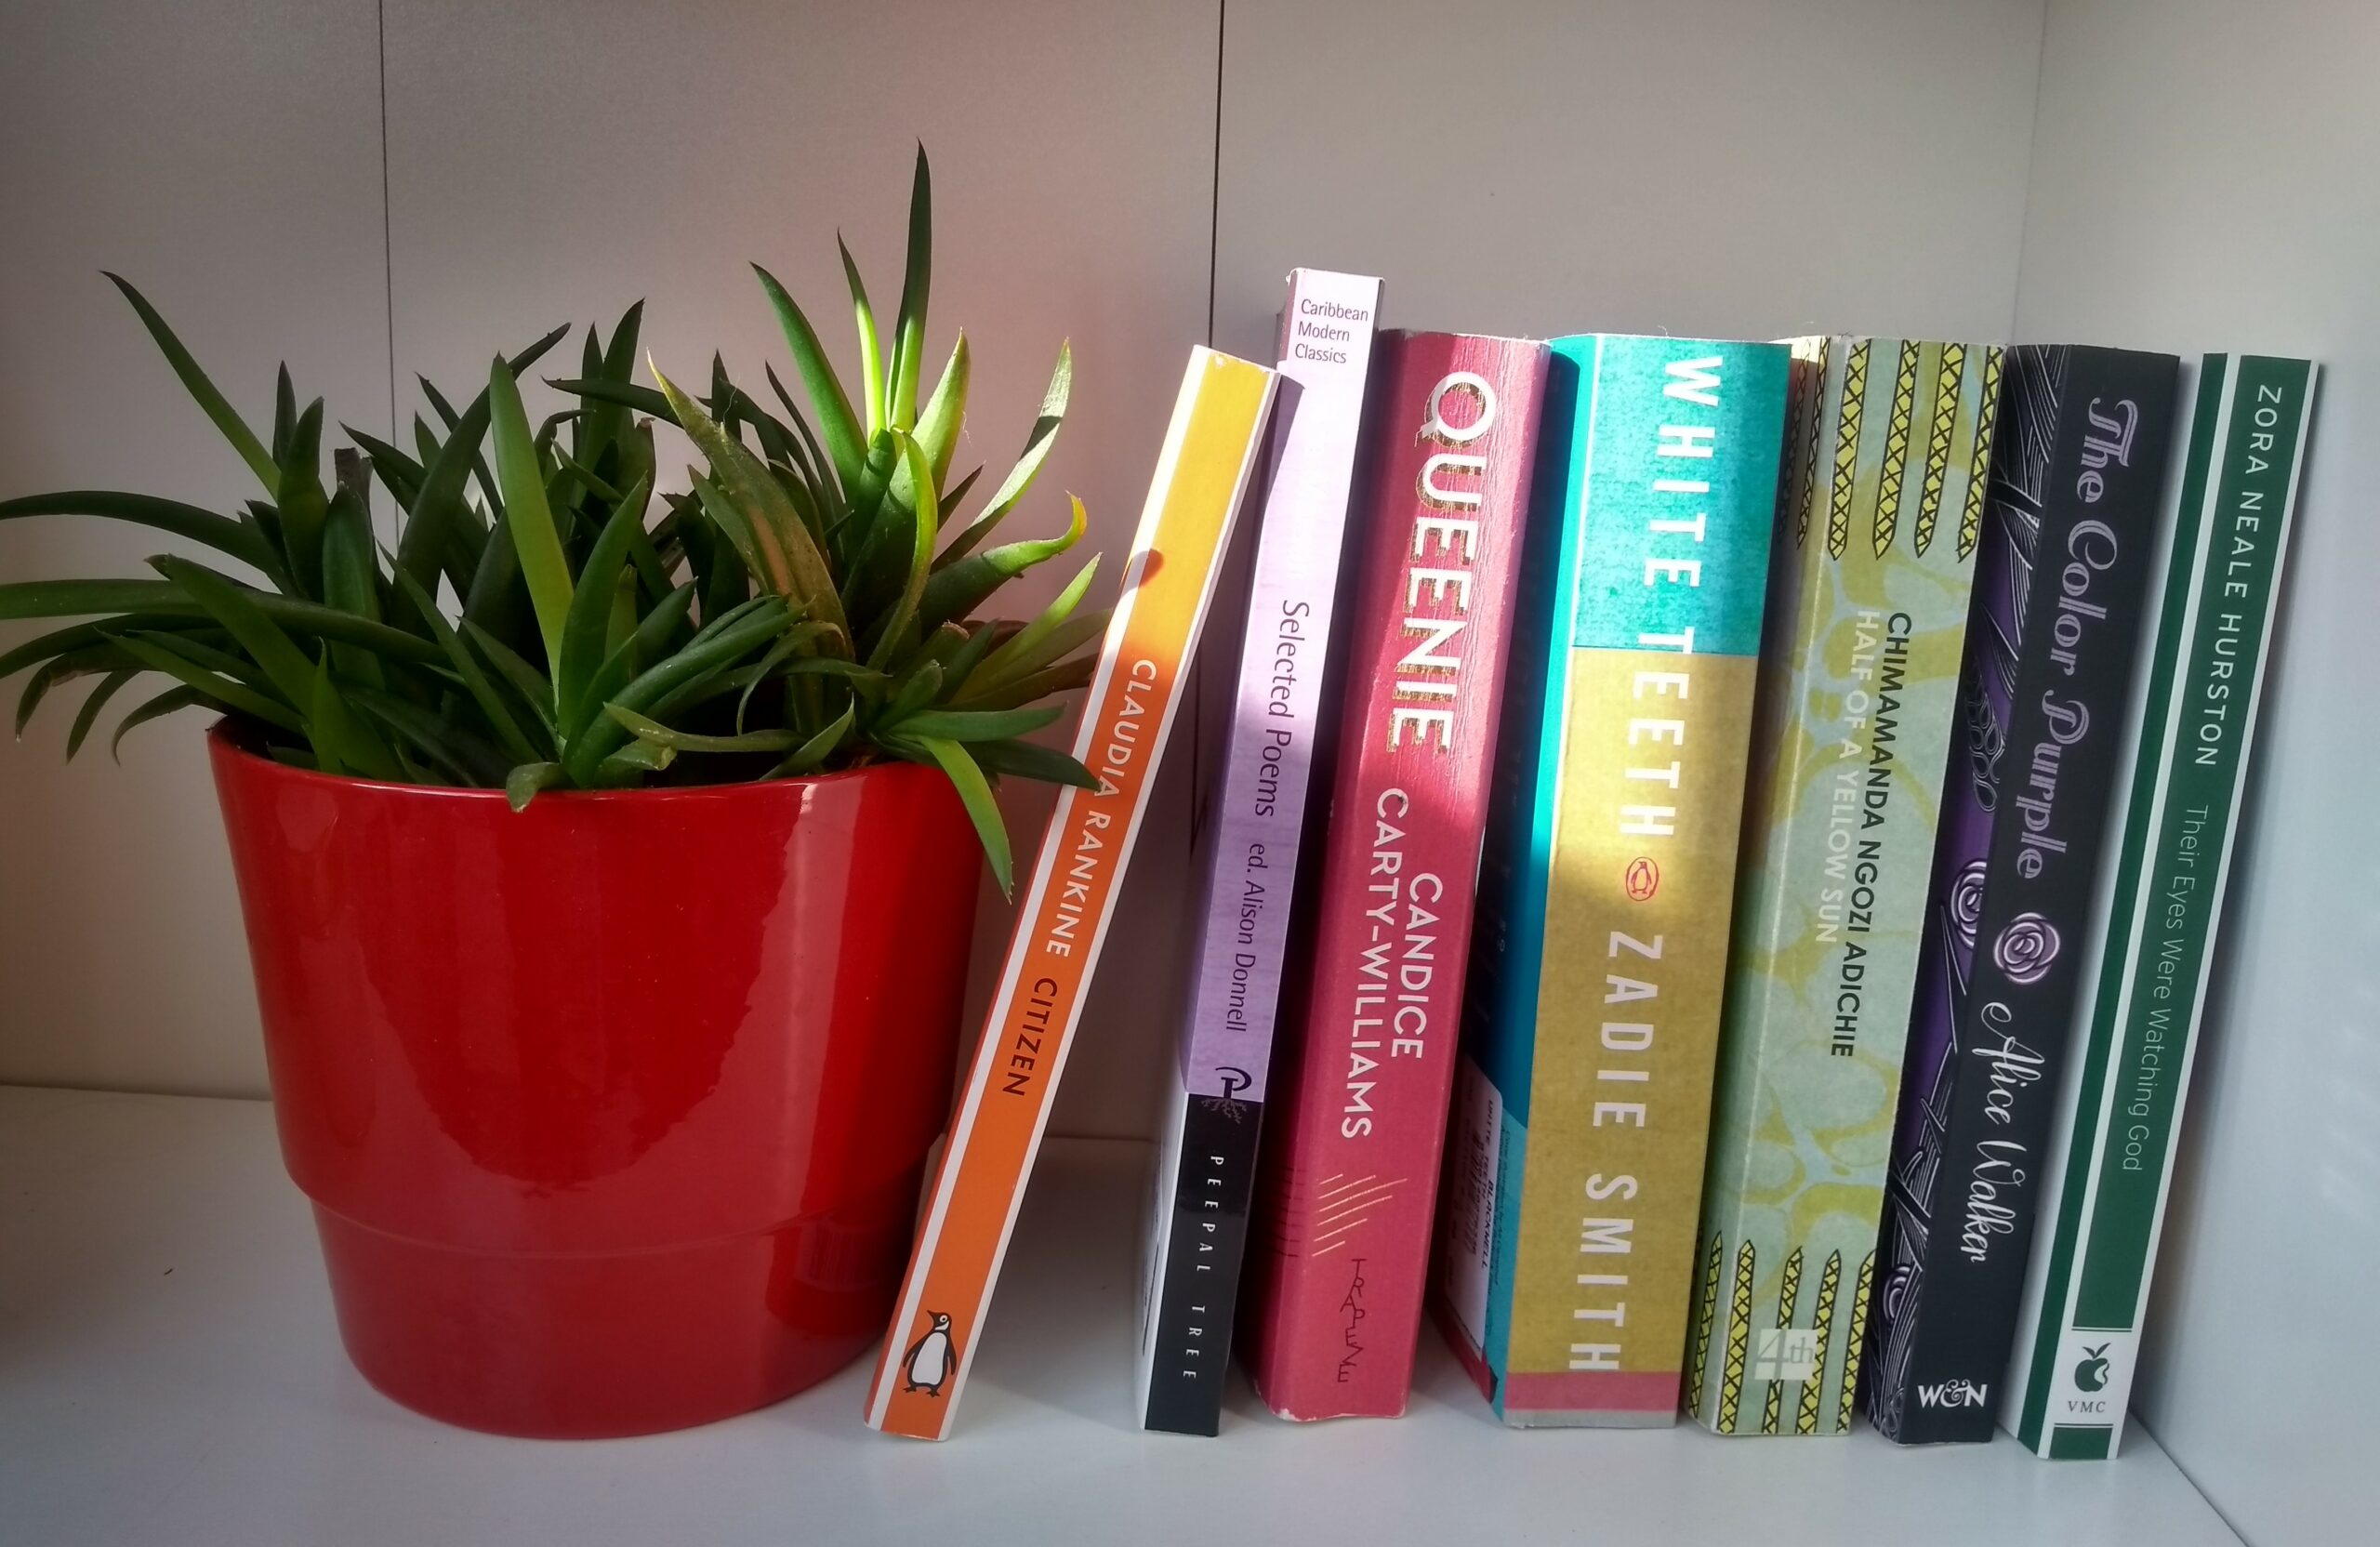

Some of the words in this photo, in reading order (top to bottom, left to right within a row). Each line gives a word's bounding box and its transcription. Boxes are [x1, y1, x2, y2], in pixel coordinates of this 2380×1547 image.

[1295, 343, 1346, 364] Classics
[1298, 321, 1350, 341] Modern
[1302, 298, 1368, 322] Caribbean
[1644, 356, 1723, 588] WHITE
[2077, 397, 2138, 504] The
[2245, 384, 2281, 474] ZORA
[1386, 372, 1496, 754] QUEENIE
[2050, 519, 2117, 677] Color
[2224, 491, 2264, 598] NEALE
[1268, 601, 1310, 719] Selected
[1850, 610, 1880, 681] HALF
[2195, 613, 2242, 765] HURSTON
[1094, 658, 1158, 797] CLAUDIA
[1620, 626, 1695, 837] TEETH
[1839, 738, 1862, 760] A
[1844, 690, 1869, 730] OF
[1861, 613, 1912, 829] CHIMAMANDA
[1255, 728, 1292, 818] Poems
[1824, 769, 1858, 878] YELLOW
[2016, 689, 2090, 879] Purple
[1046, 810, 1112, 958] RANKINE
[1247, 842, 1267, 874] ed.
[1847, 840, 1880, 932] NGOZI
[2177, 804, 2208, 867] Their
[1237, 879, 1265, 945] Alison
[1816, 888, 1844, 944] SUN
[2165, 876, 2195, 930] Eyes
[1226, 954, 1256, 1032] Donnell
[1341, 787, 1408, 1140] CARTY-WILLIAMS
[1391, 872, 1443, 1059] CANDICE
[1831, 941, 1867, 1057] ADICHIE
[2153, 939, 2185, 999] Were
[1002, 978, 1058, 1097] CITIZEN
[1593, 931, 1663, 1127] ZADIE
[1972, 1001, 2045, 1125] Alice
[2127, 1008, 2172, 1117] Watching
[1959, 1139, 2028, 1264] Walker
[2122, 1125, 2149, 1170] God
[1197, 1156, 1224, 1272] PEEPAL
[1337, 1258, 1367, 1382] TRAPEZE
[1569, 1173, 1638, 1370] SMITH
[1183, 1305, 1206, 1379] TREE
[1917, 1379, 1988, 1408] W&N
[2067, 1399, 2106, 1413] VMC
